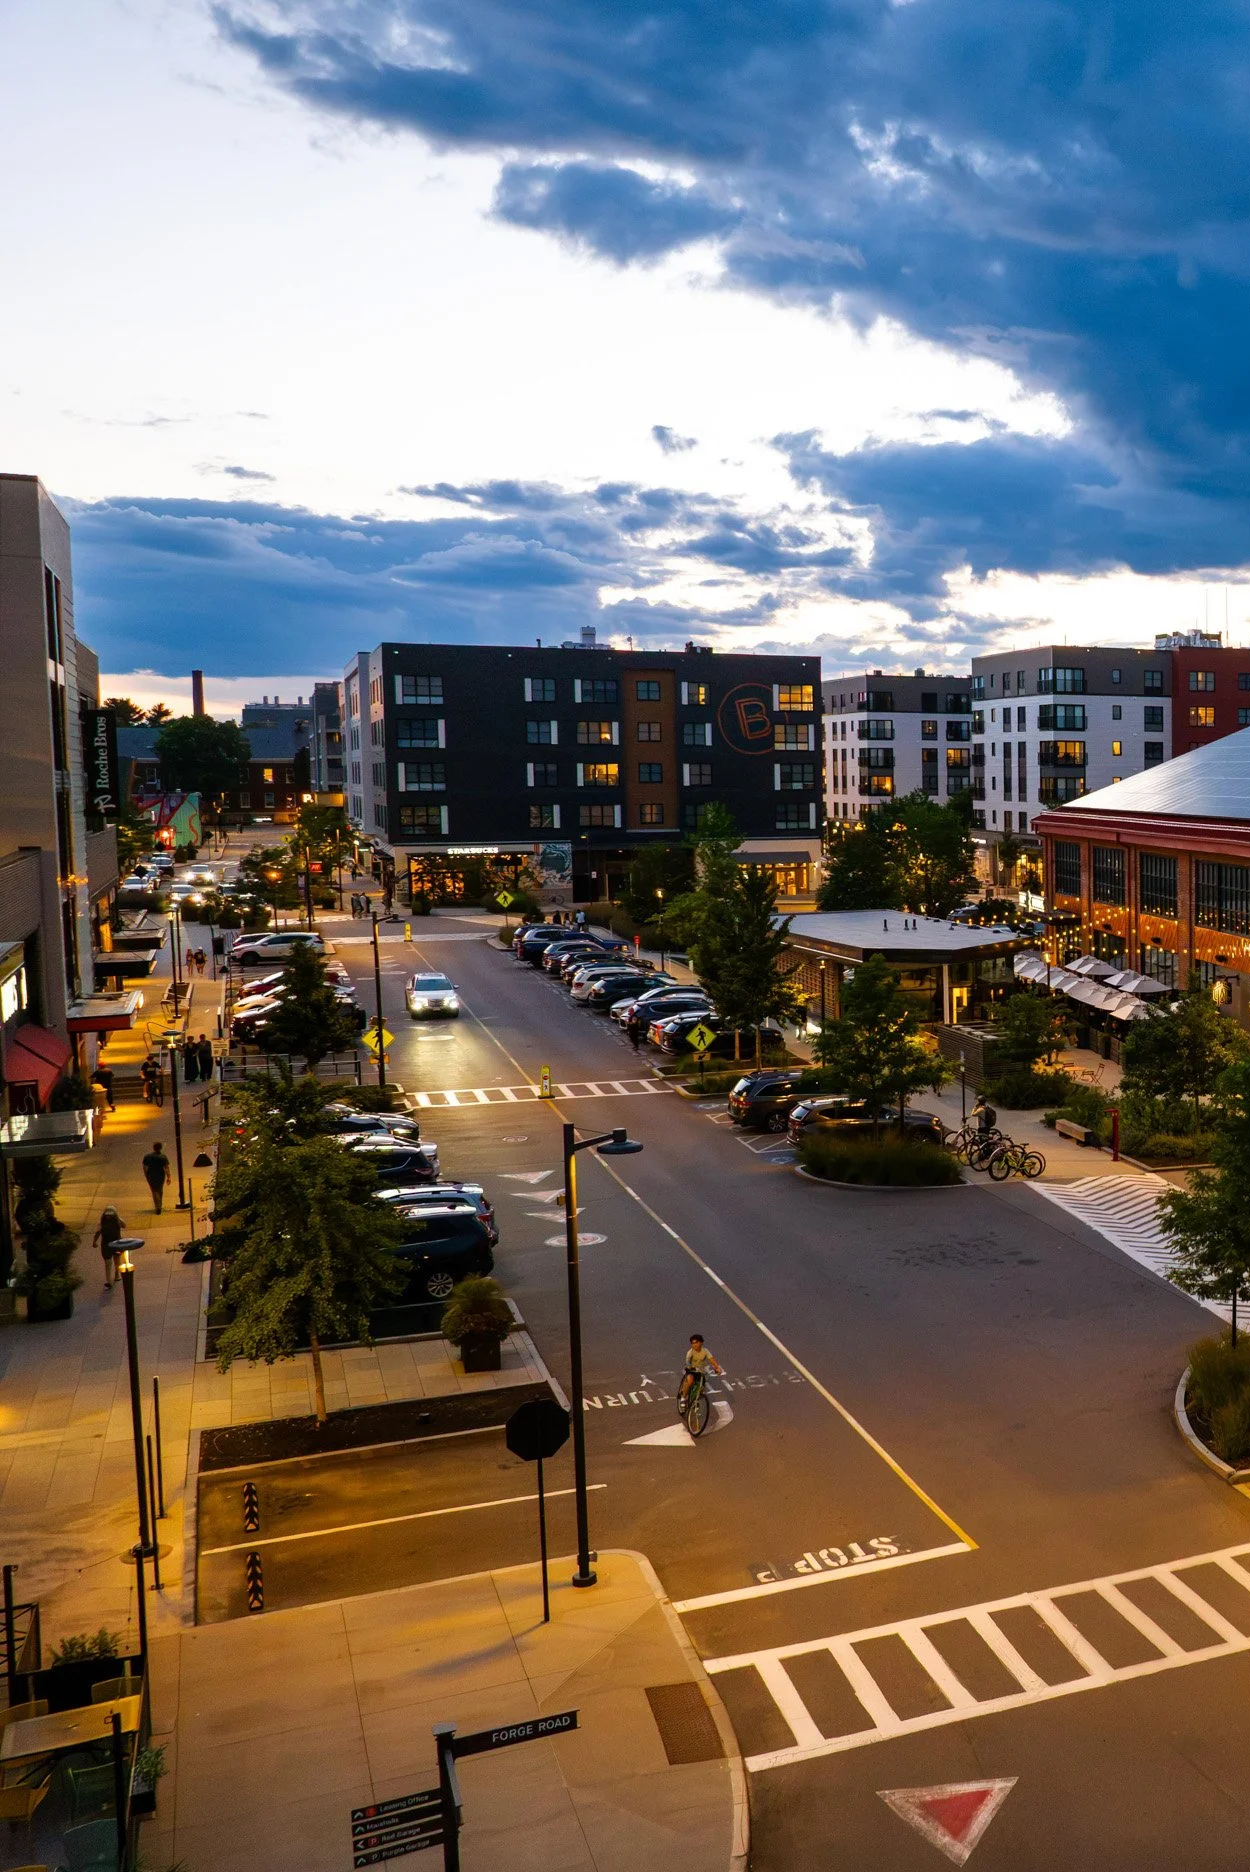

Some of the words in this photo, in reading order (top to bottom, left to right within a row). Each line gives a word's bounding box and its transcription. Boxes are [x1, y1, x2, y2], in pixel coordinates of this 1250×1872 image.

[93, 716, 108, 747] Bros
[94, 748, 110, 789] Roche
[447, 847, 499, 855] STARBUCKS
[793, 1536, 901, 1574] STOP
[491, 1725, 534, 1743] FORGE
[538, 1716, 571, 1732] ROAD
[407, 1795, 429, 1805] Office
